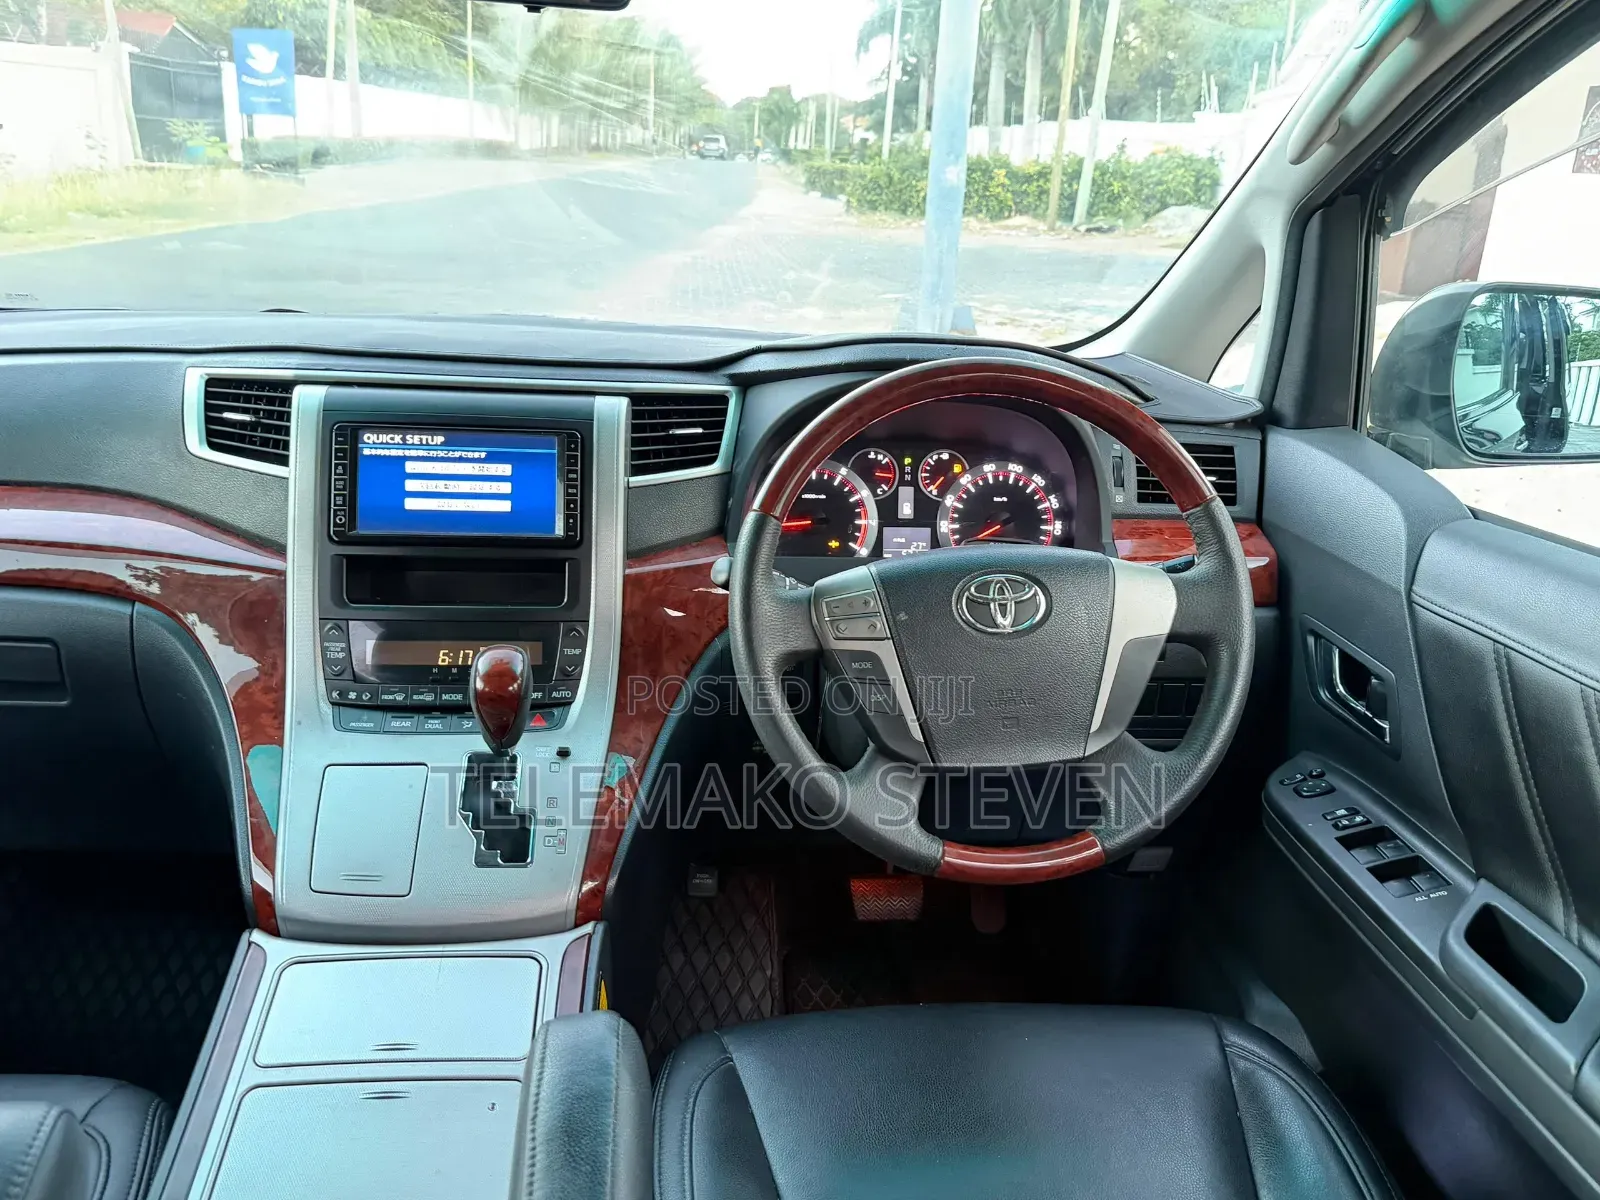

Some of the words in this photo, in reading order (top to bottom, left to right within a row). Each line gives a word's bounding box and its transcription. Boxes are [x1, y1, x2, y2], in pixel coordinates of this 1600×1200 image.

[363, 433, 403, 444] QUICK
[405, 434, 445, 445] SETUP
[904, 457, 912, 465] P
[983, 463, 996, 472] 80
[1008, 463, 1024, 473] 100
[1031, 473, 1046, 487] 120
[1048, 494, 1060, 509] 140
[325, 651, 346, 659] TEMP
[562, 648, 582, 656] TEMP
[437, 649, 474, 666] 6:17
[851, 661, 873, 669] MODE
[441, 693, 463, 701] MODE
[551, 690, 572, 698] AUTO
[548, 799, 556, 807] R
[547, 817, 555, 826] N
[546, 837, 553, 845] D
[558, 837, 565, 845] M
[1429, 890, 1448, 899] AUTO
